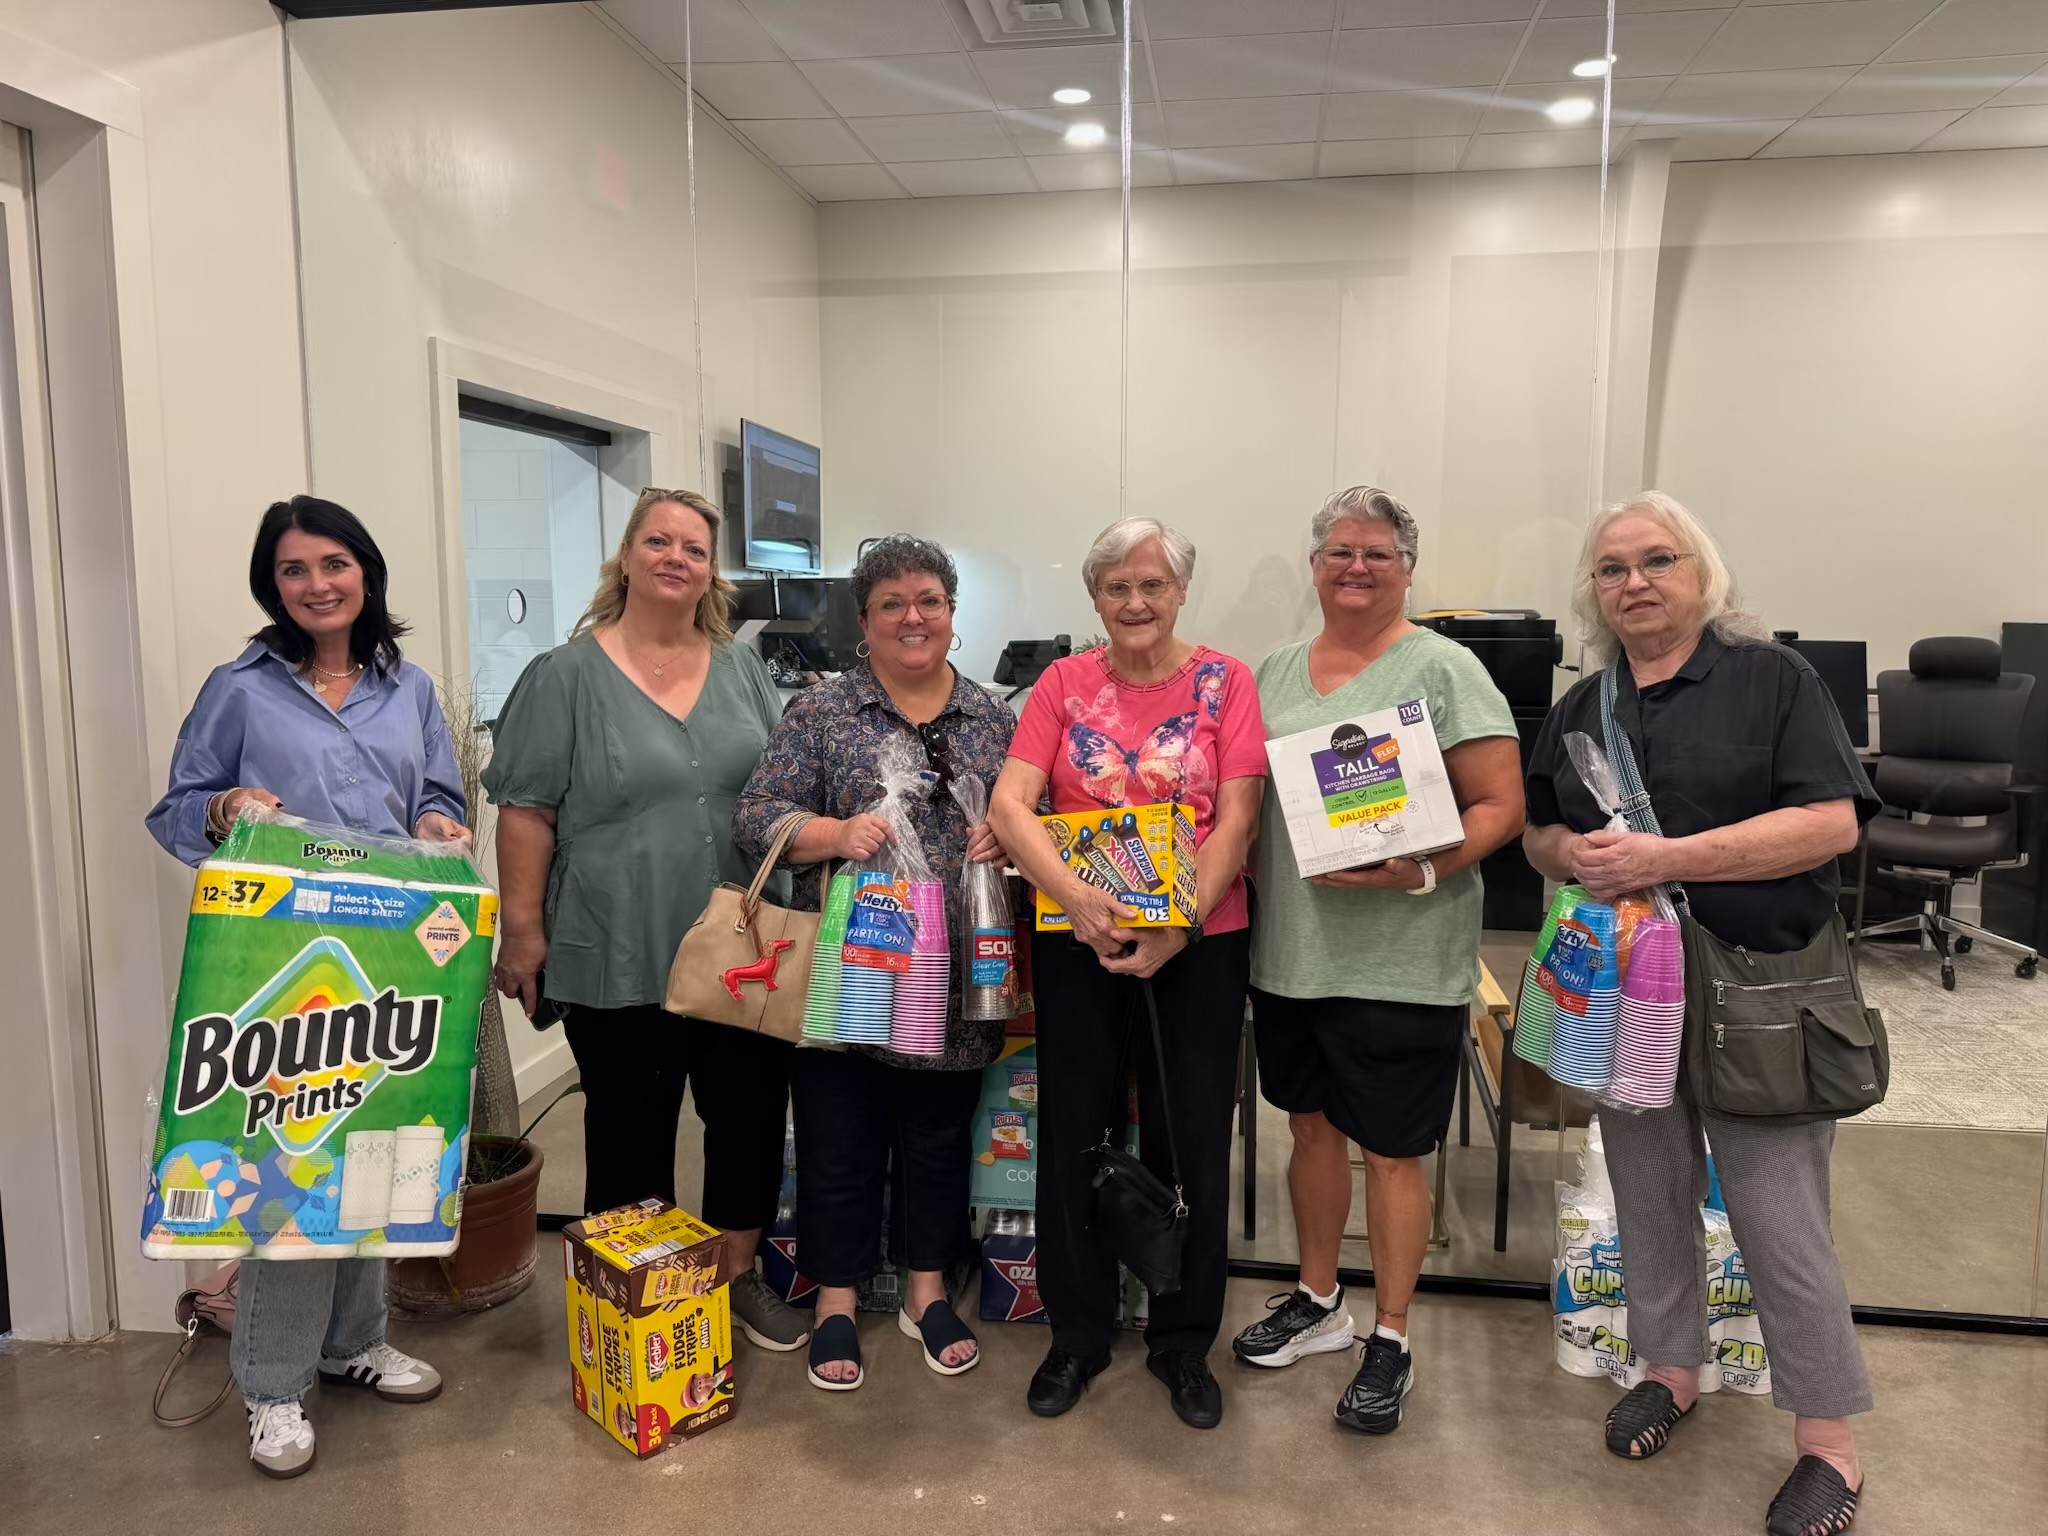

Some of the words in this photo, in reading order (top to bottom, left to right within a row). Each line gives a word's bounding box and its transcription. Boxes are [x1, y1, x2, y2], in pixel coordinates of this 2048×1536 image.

[1400, 704, 1420, 717] 110
[1402, 714, 1422, 723] COUNT
[1376, 744, 1398, 758] FLEX
[1333, 757, 1379, 778] TALL
[1324, 778, 1350, 789] KITCHEN
[1351, 772, 1378, 783] GARBAGE
[1379, 767, 1395, 776] BAGS
[1350, 775, 1387, 788] DRAWSTRING
[1126, 815, 1132, 824] 8
[1338, 808, 1372, 824] VALUE
[1373, 801, 1402, 815] PACK
[1082, 829, 1088, 837] 4
[1103, 820, 1109, 829] 7
[303, 843, 368, 859] Bounty
[1062, 851, 1069, 859] 6
[1127, 839, 1156, 881] SNICKERS
[1090, 851, 1108, 872] Way
[1106, 838, 1140, 890] TWIX
[1105, 867, 1124, 890] Milky
[333, 905, 370, 915] LONGER
[334, 893, 405, 908] select-a-size
[862, 893, 900, 912] Hefty
[1149, 897, 1163, 907] FULL
[1144, 907, 1170, 922] 30
[427, 932, 459, 942] PRINTS
[847, 928, 881, 940] PARTY
[883, 933, 906, 947] ON!
[886, 957, 895, 966] 16
[1539, 969, 1554, 985] 100
[1563, 970, 1584, 987] ON!
[178, 990, 438, 1110] Bounty
[246, 1078, 363, 1134] Prints
[995, 1115, 1022, 1125] RUFFLES
[1575, 1267, 1624, 1297] CUP
[685, 1314, 698, 1366] STRIPES
[700, 1317, 709, 1348] Minis
[673, 1320, 685, 1370] FUDGE
[603, 1323, 614, 1387] FUDGE
[612, 1327, 622, 1394] STRIPES
[650, 1336, 666, 1377] Keebler
[1596, 1357, 1607, 1368] 16
[1720, 1339, 1764, 1371] 20
[622, 1348, 632, 1389] Minis
[1723, 1371, 1735, 1382] 16
[648, 1425, 661, 1447] 36
